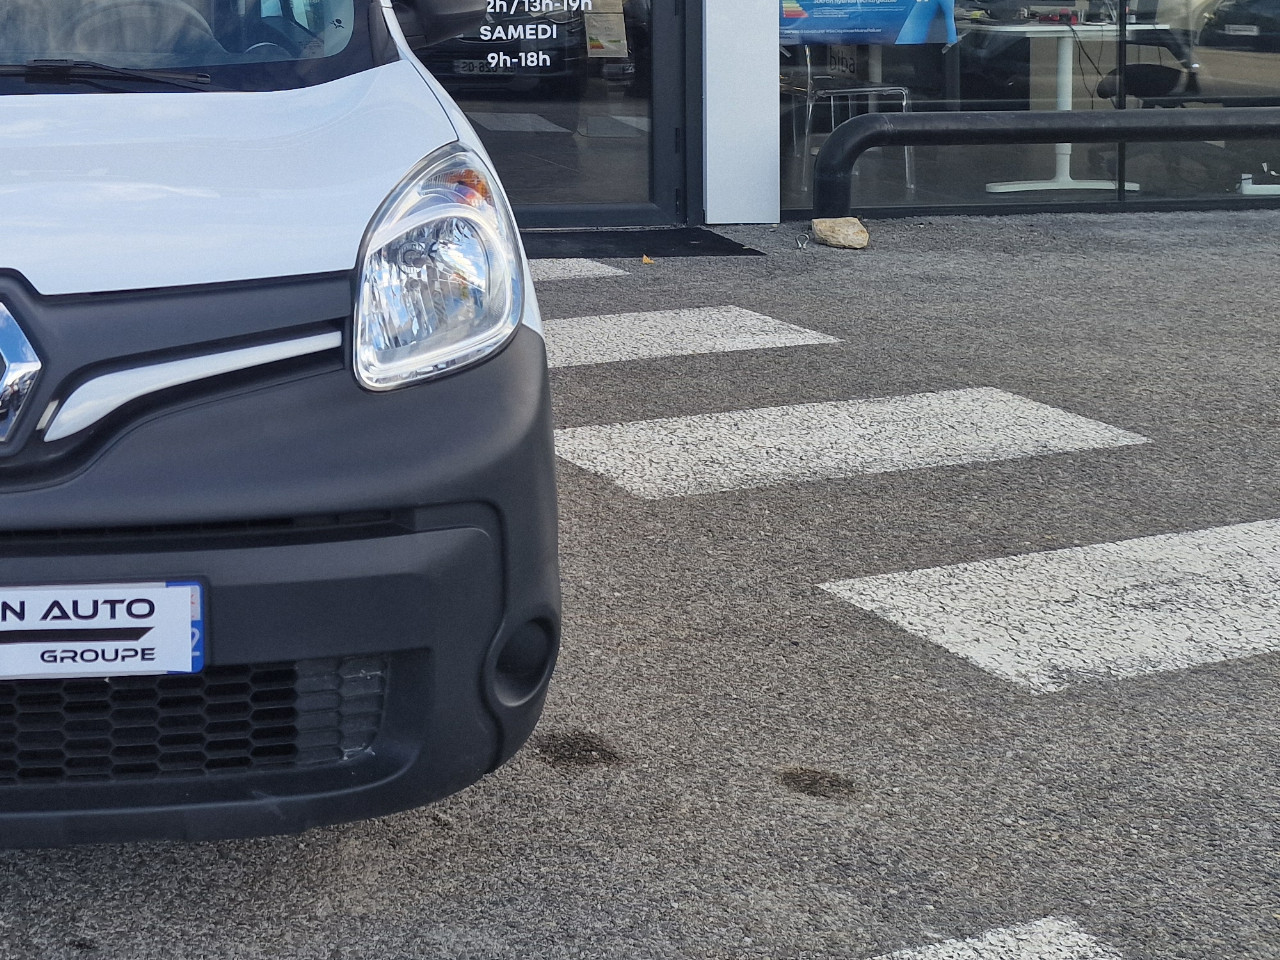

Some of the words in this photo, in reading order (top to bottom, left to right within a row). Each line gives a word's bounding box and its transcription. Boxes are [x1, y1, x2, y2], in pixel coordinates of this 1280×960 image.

[479, 24, 557, 40] SAMEDI
[487, 51, 551, 68] 9h-18h
[40, 598, 156, 622] AUTO
[40, 647, 156, 664] GROUPE
